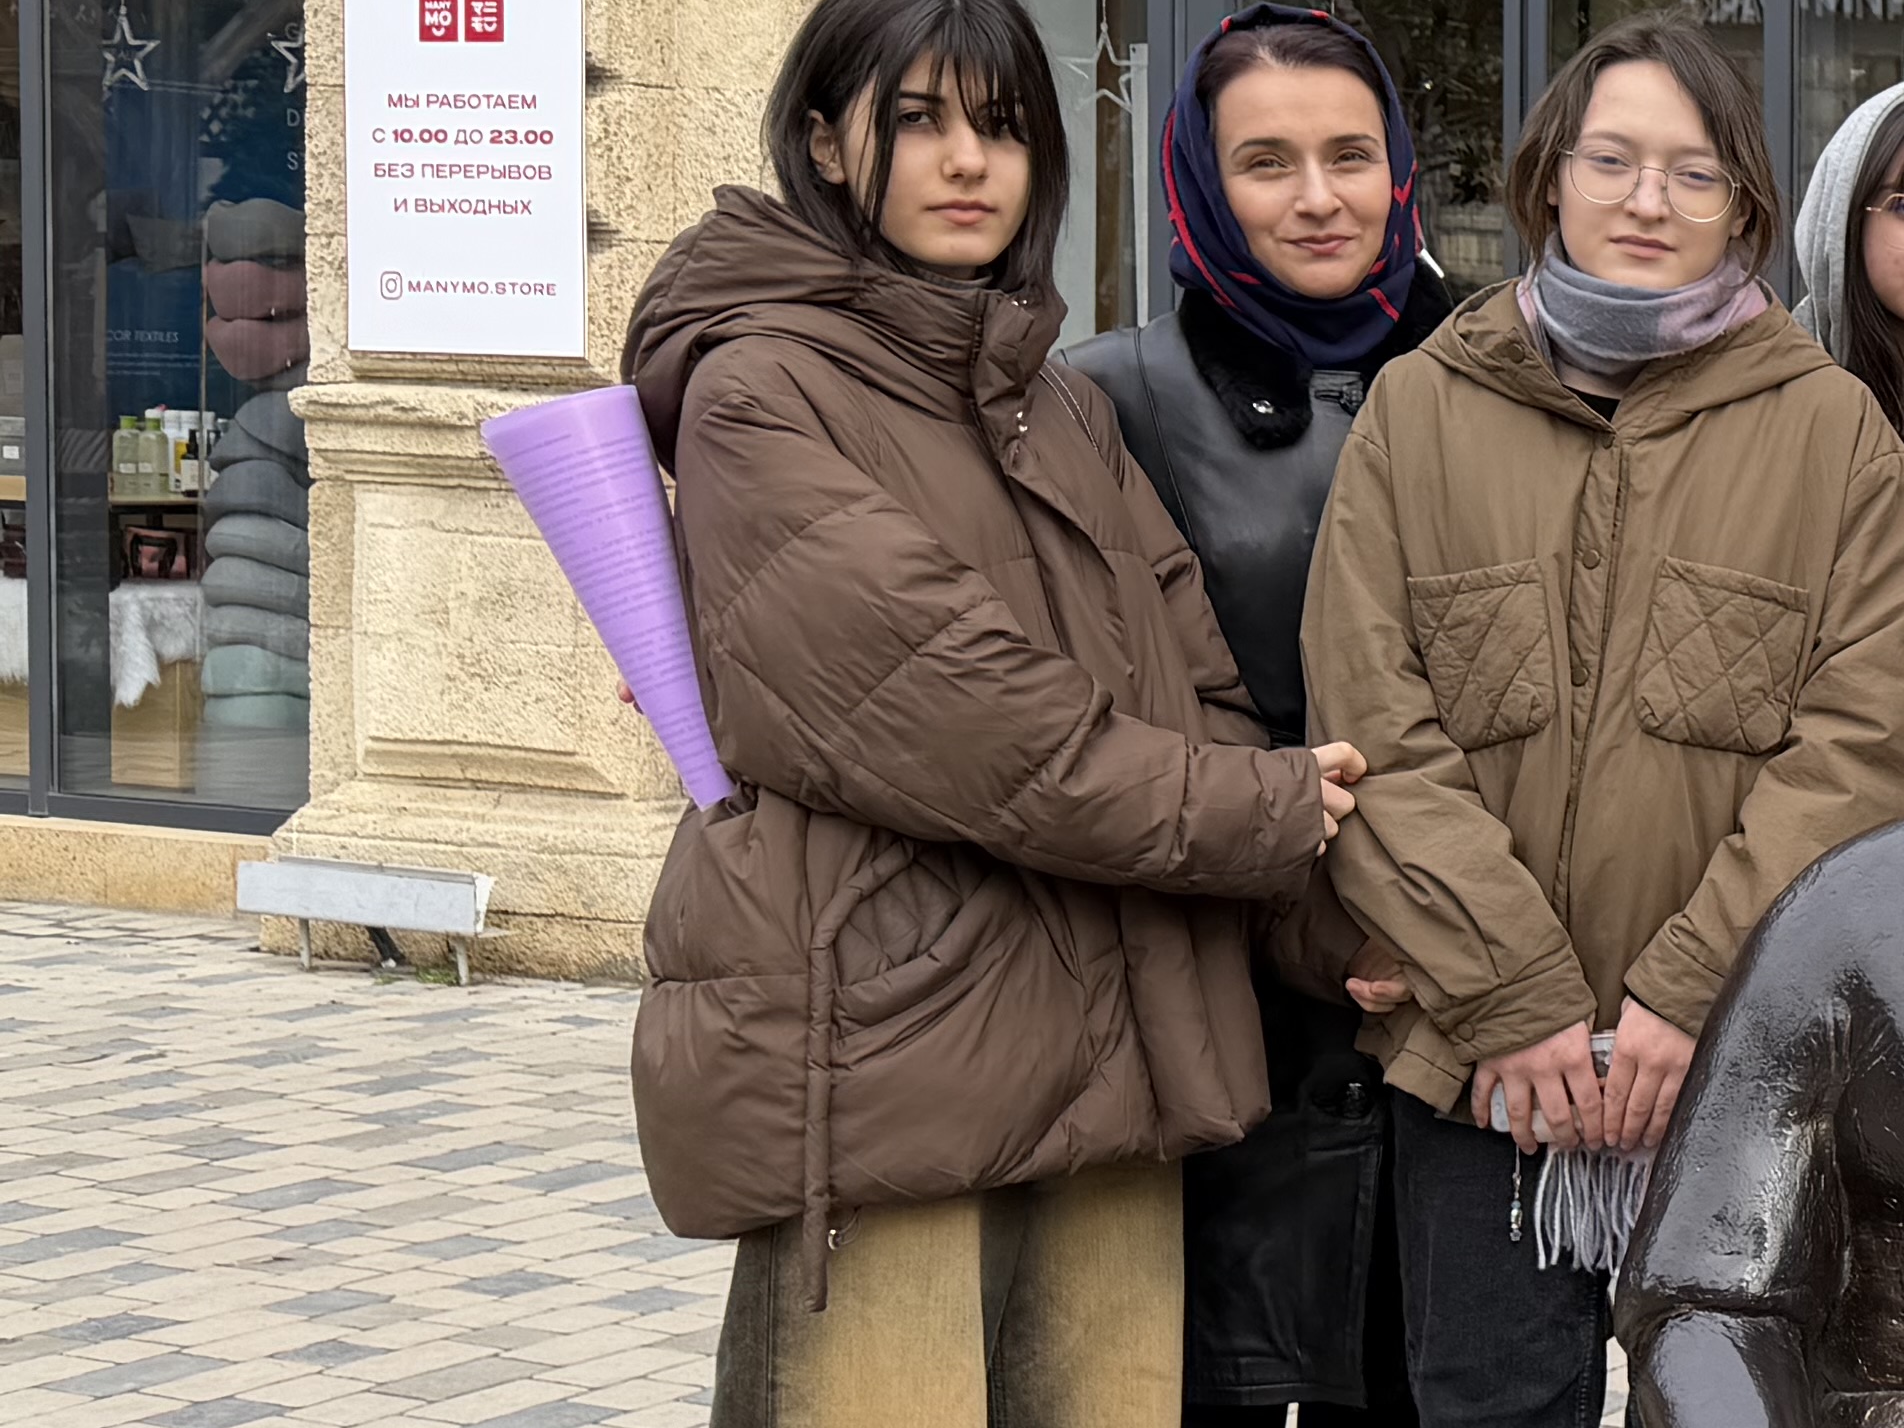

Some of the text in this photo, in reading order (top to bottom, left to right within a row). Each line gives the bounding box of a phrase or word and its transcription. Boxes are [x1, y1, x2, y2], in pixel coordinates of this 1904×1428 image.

[424, 10, 452, 26] MO
[387, 93, 537, 110] МЫ РАБОТАЕМ
[372, 128, 554, 145] С 10.00 ДО 23.00
[373, 163, 553, 181] БЕЗ ПЕРЕРЫВОВ
[393, 197, 532, 216] И ВЫХОДНЫХ
[407, 281, 557, 296] MANYMO.STORE
